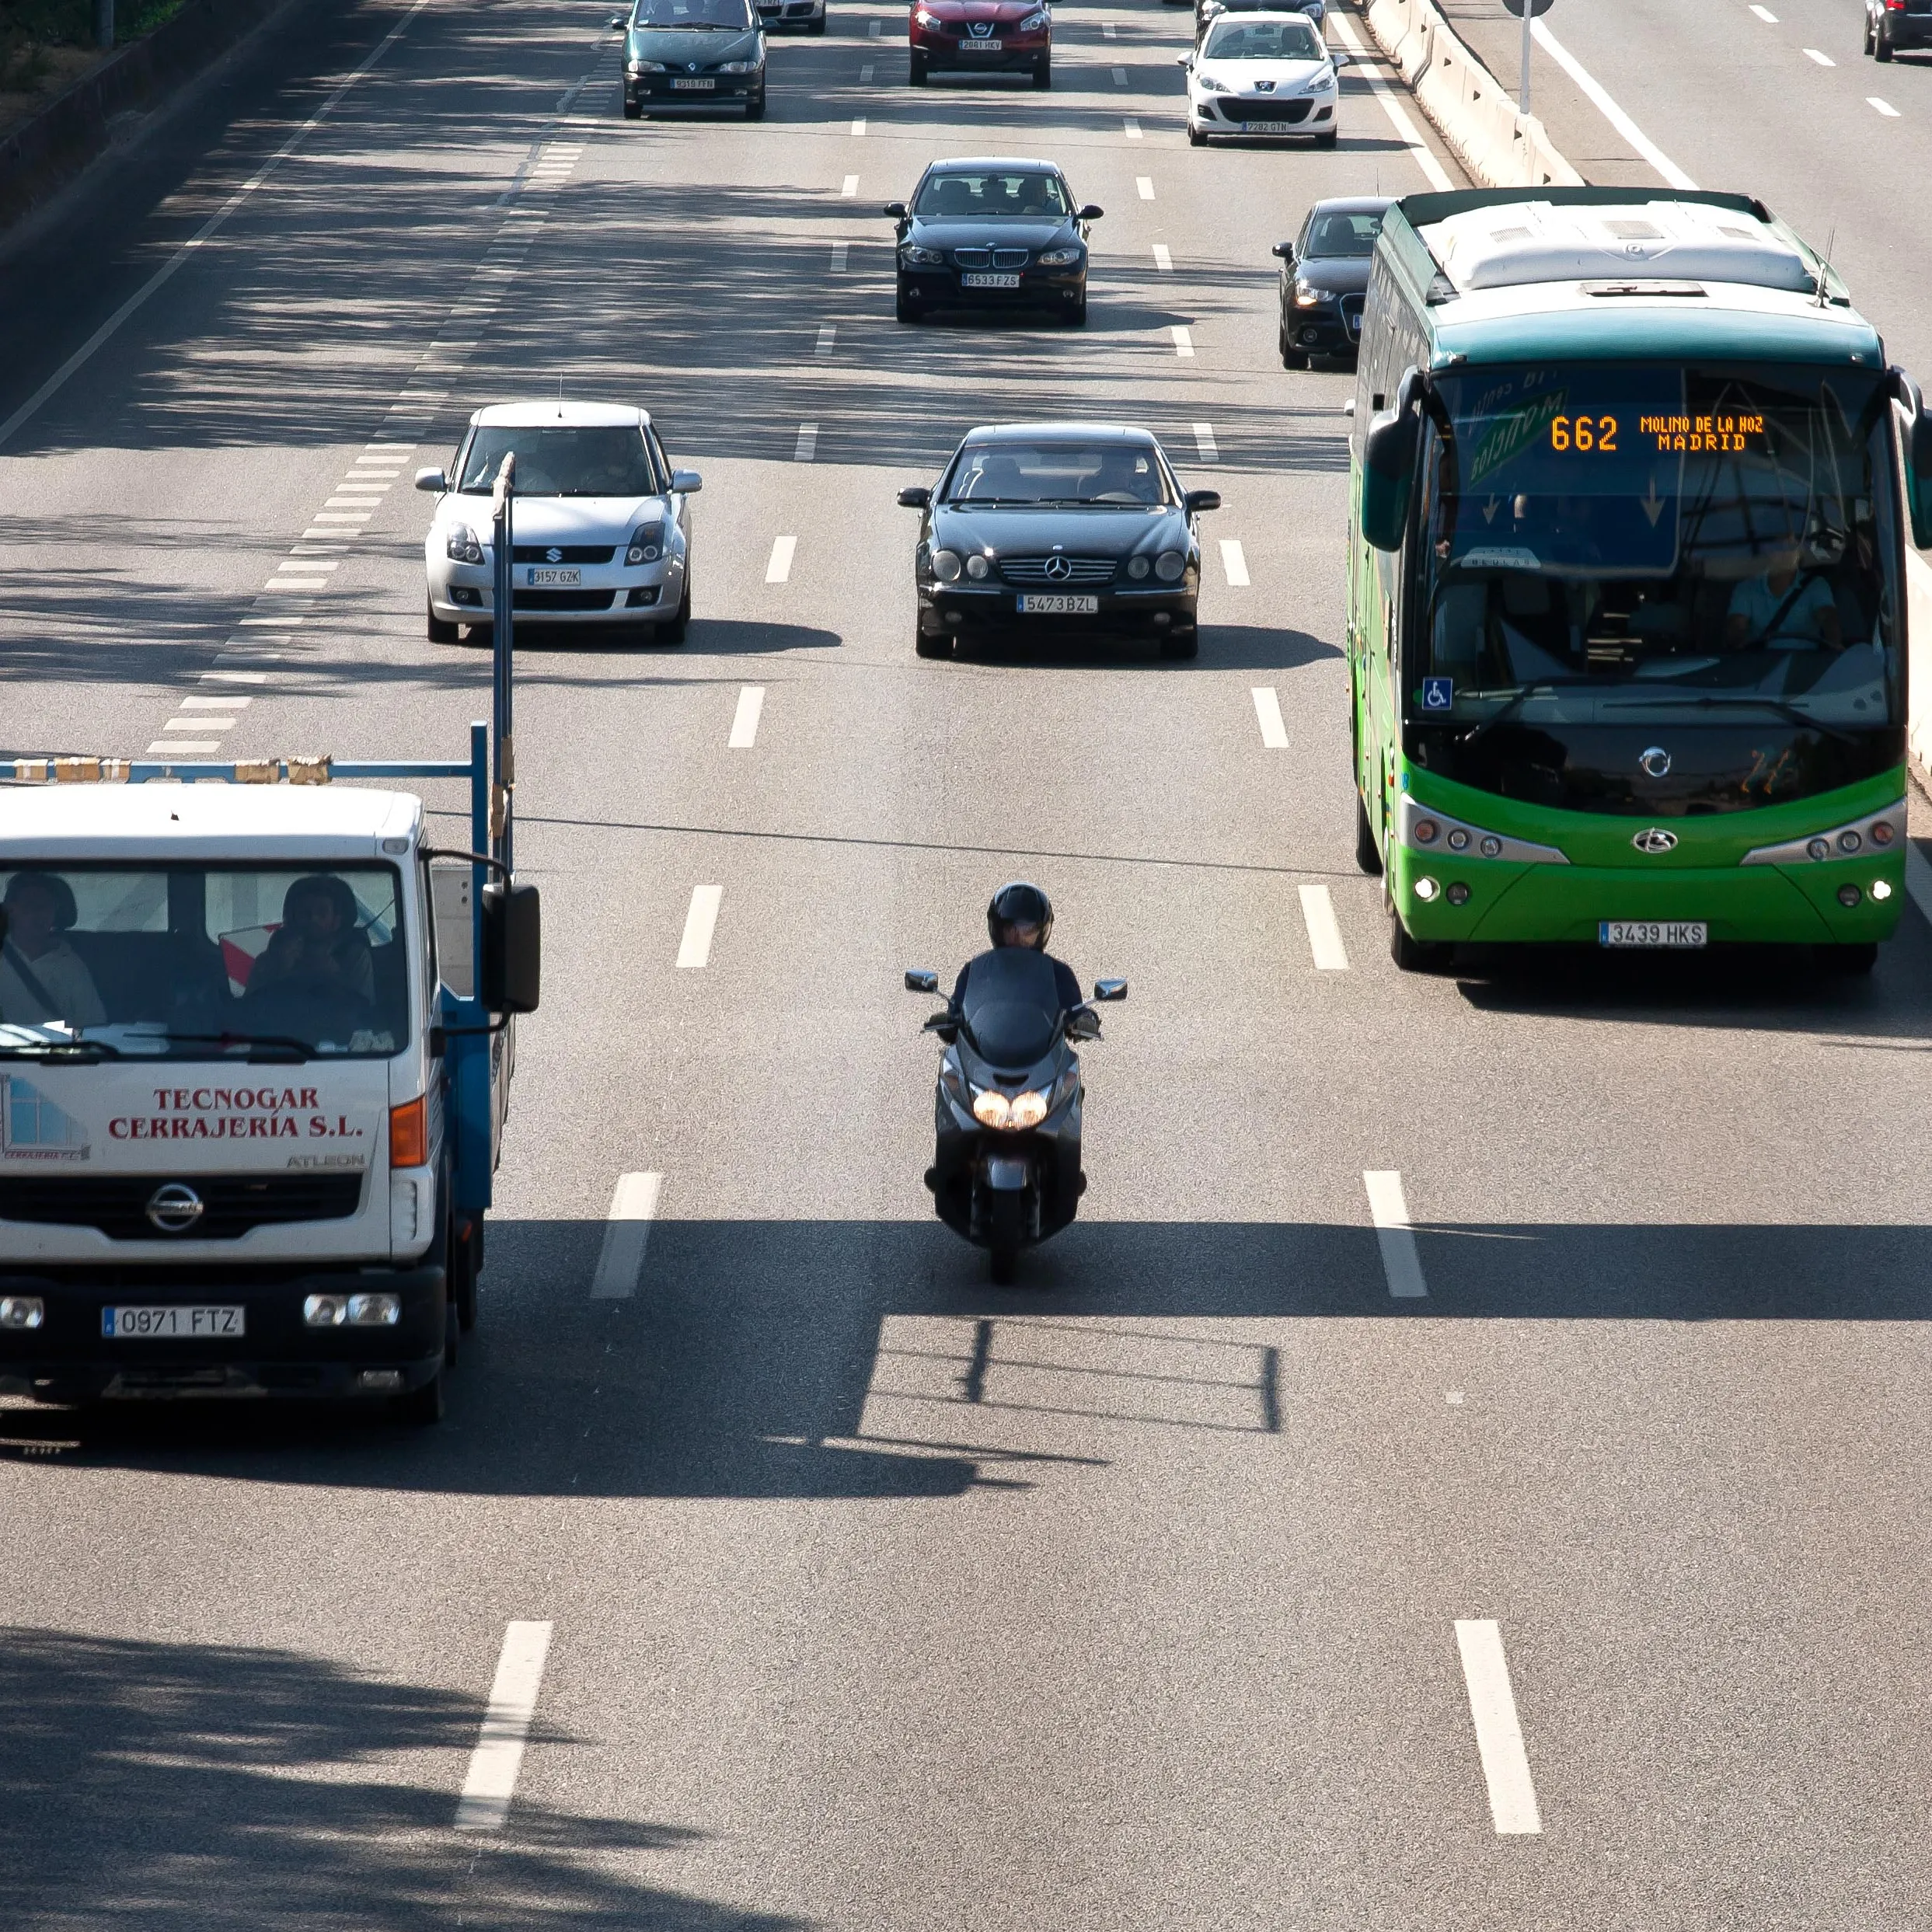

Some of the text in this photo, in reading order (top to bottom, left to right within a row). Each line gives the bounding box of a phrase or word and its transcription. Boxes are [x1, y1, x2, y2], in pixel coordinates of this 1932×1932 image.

[968, 274, 1017, 286] 6533 FZS
[1552, 416, 1617, 451] 662
[1640, 416, 1763, 433] MOLINO DE LA HOZ
[1658, 434, 1745, 451] MADRID
[534, 570, 579, 583] 3157 GZK
[1613, 923, 1702, 944] 3439 HKS
[152, 1087, 319, 1111] TECNOGAR
[108, 1107, 364, 1139] CERRAJERÍA S.L.
[122, 1309, 236, 1334] 0971 FTZ
